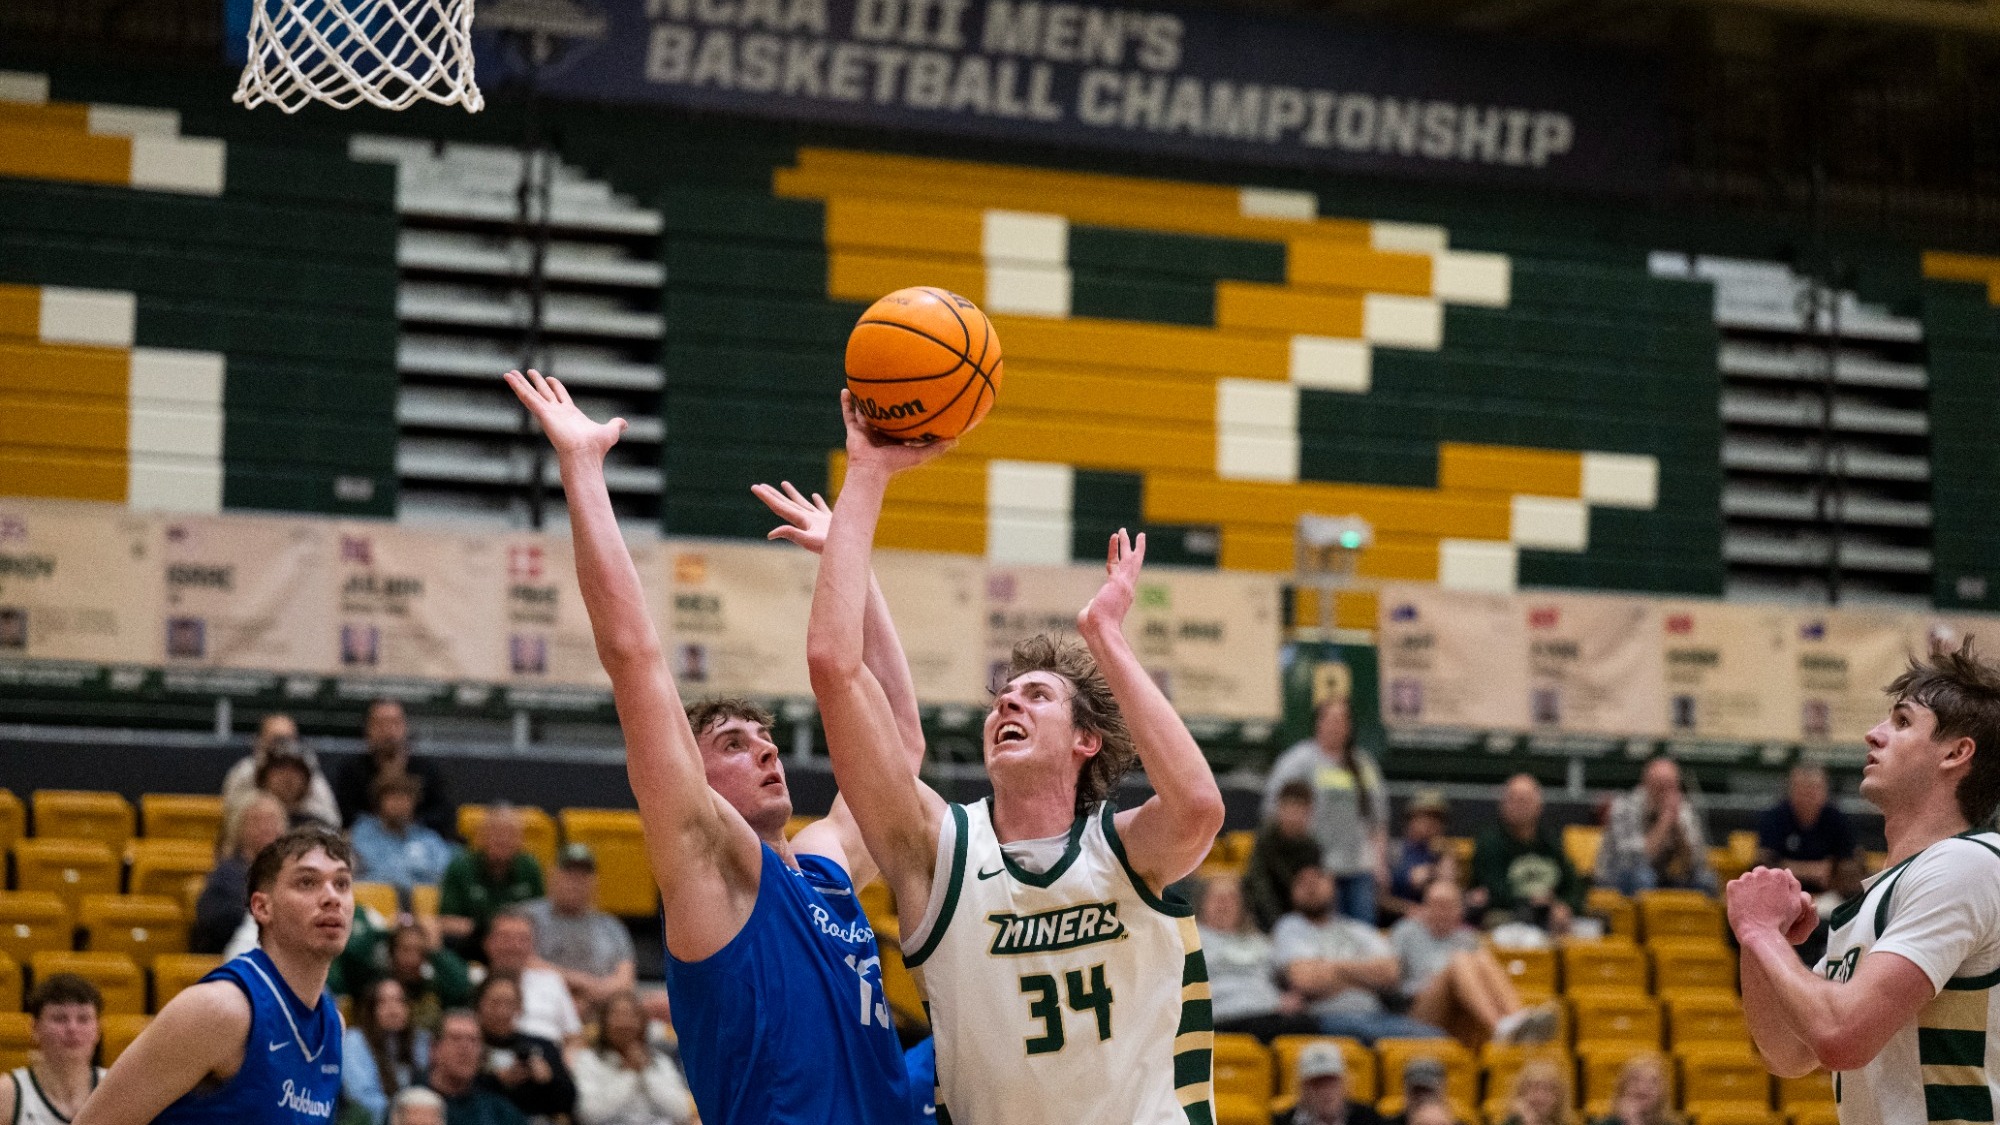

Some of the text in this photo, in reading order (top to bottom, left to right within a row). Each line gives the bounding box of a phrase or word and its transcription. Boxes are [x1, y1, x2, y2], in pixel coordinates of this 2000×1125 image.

[979, 2, 1184, 70] MEN'S
[645, 23, 1573, 167] BASKETBALL CHAMPIONSHIP
[998, 907, 1120, 949] MINERS
[1019, 963, 1113, 1055] 34
